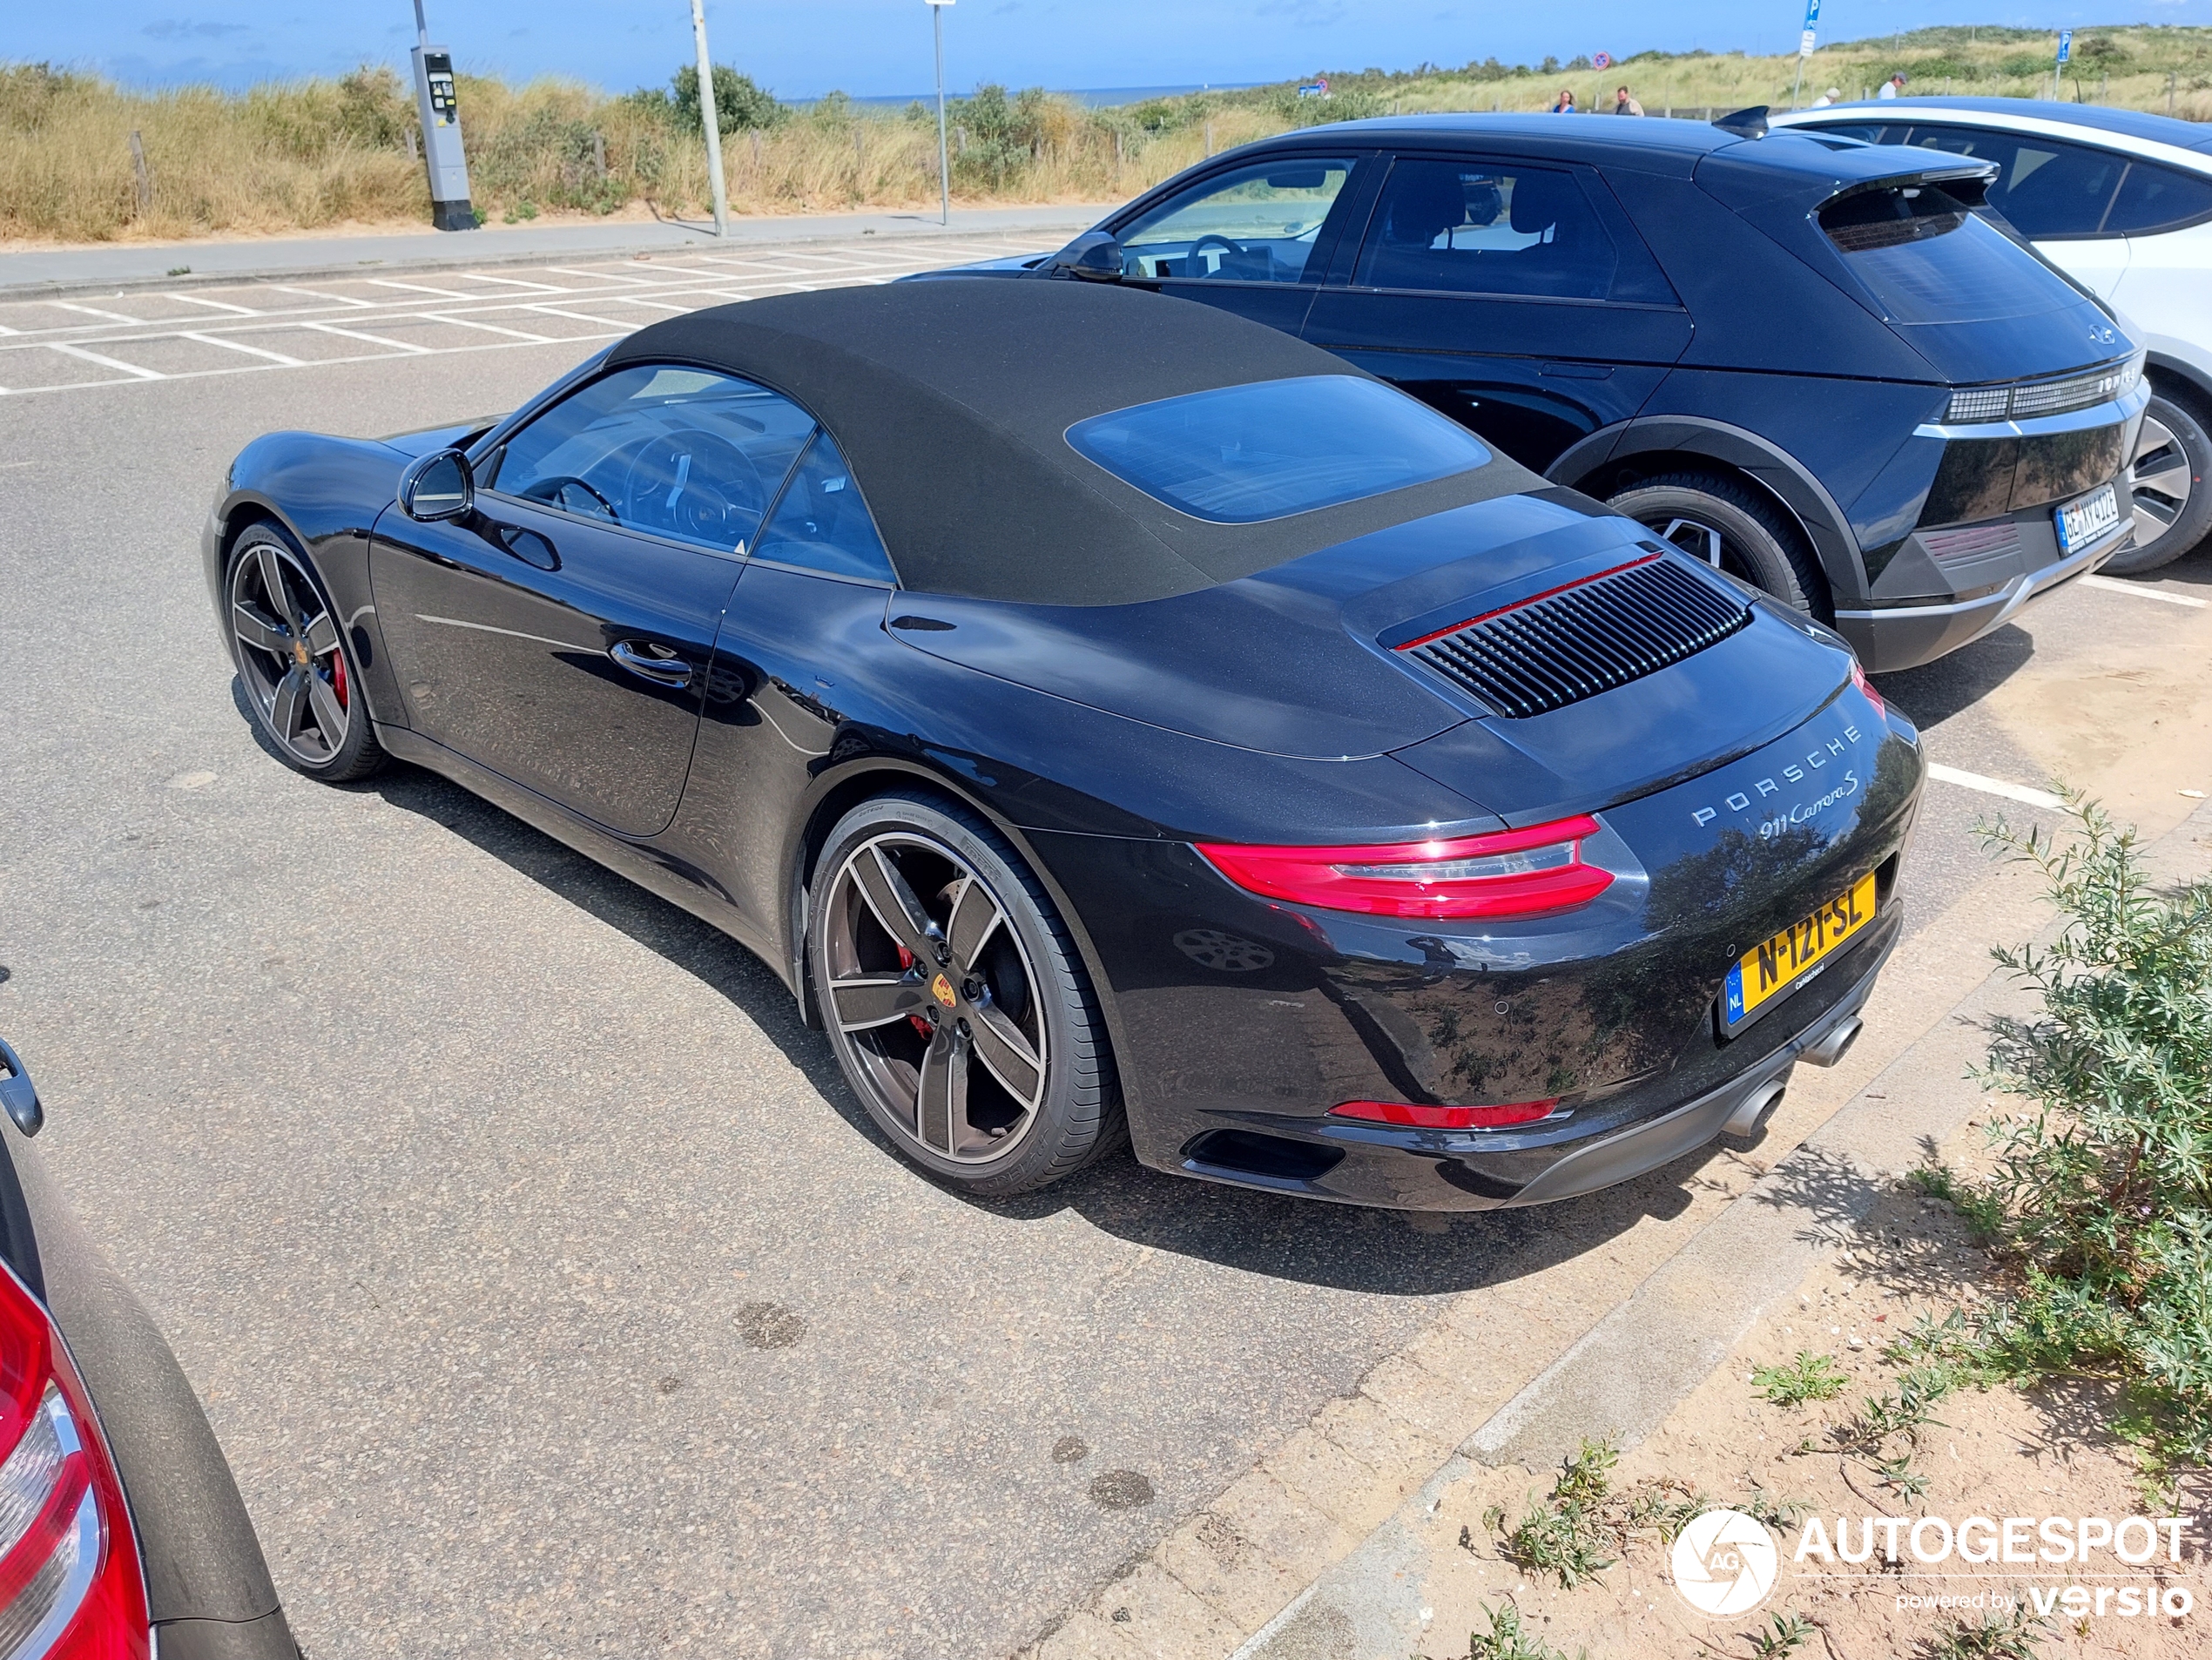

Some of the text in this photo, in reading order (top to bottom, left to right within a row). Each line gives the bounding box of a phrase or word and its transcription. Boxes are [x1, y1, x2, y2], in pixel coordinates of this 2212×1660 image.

[2064, 509, 2079, 538] GE
[1691, 725, 1862, 828] PORSCHE
[1759, 769, 1859, 840] 911 Carrera S
[1757, 887, 1863, 993] N-121-SL
[1730, 992, 1742, 1011] NL
